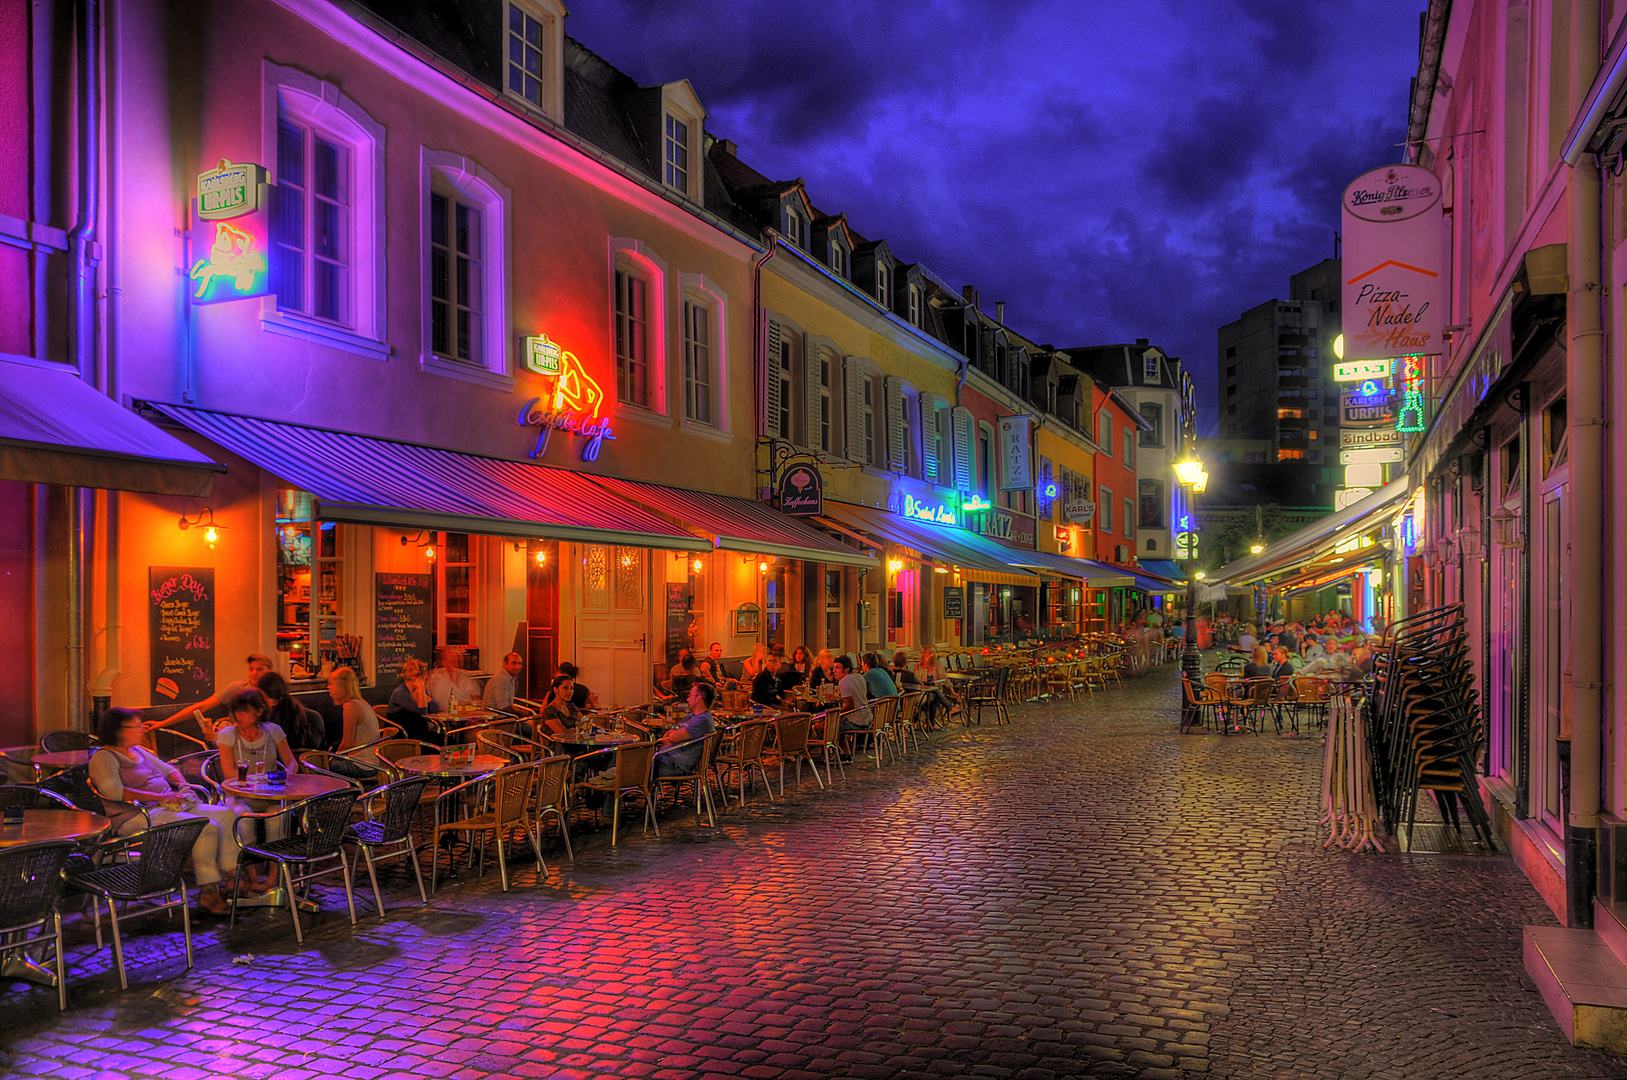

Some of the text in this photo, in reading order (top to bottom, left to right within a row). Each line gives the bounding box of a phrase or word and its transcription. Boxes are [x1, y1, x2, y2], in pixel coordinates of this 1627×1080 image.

[1356, 284, 1409, 305] Pizza-
[1367, 302, 1430, 327] Nudel
[1384, 327, 1431, 350] Haus
[1344, 432, 1399, 443] Sindbad
[1010, 433, 1021, 475] RATZ
[1066, 504, 1095, 512] KARL'S
[985, 511, 1013, 540] RATZ
